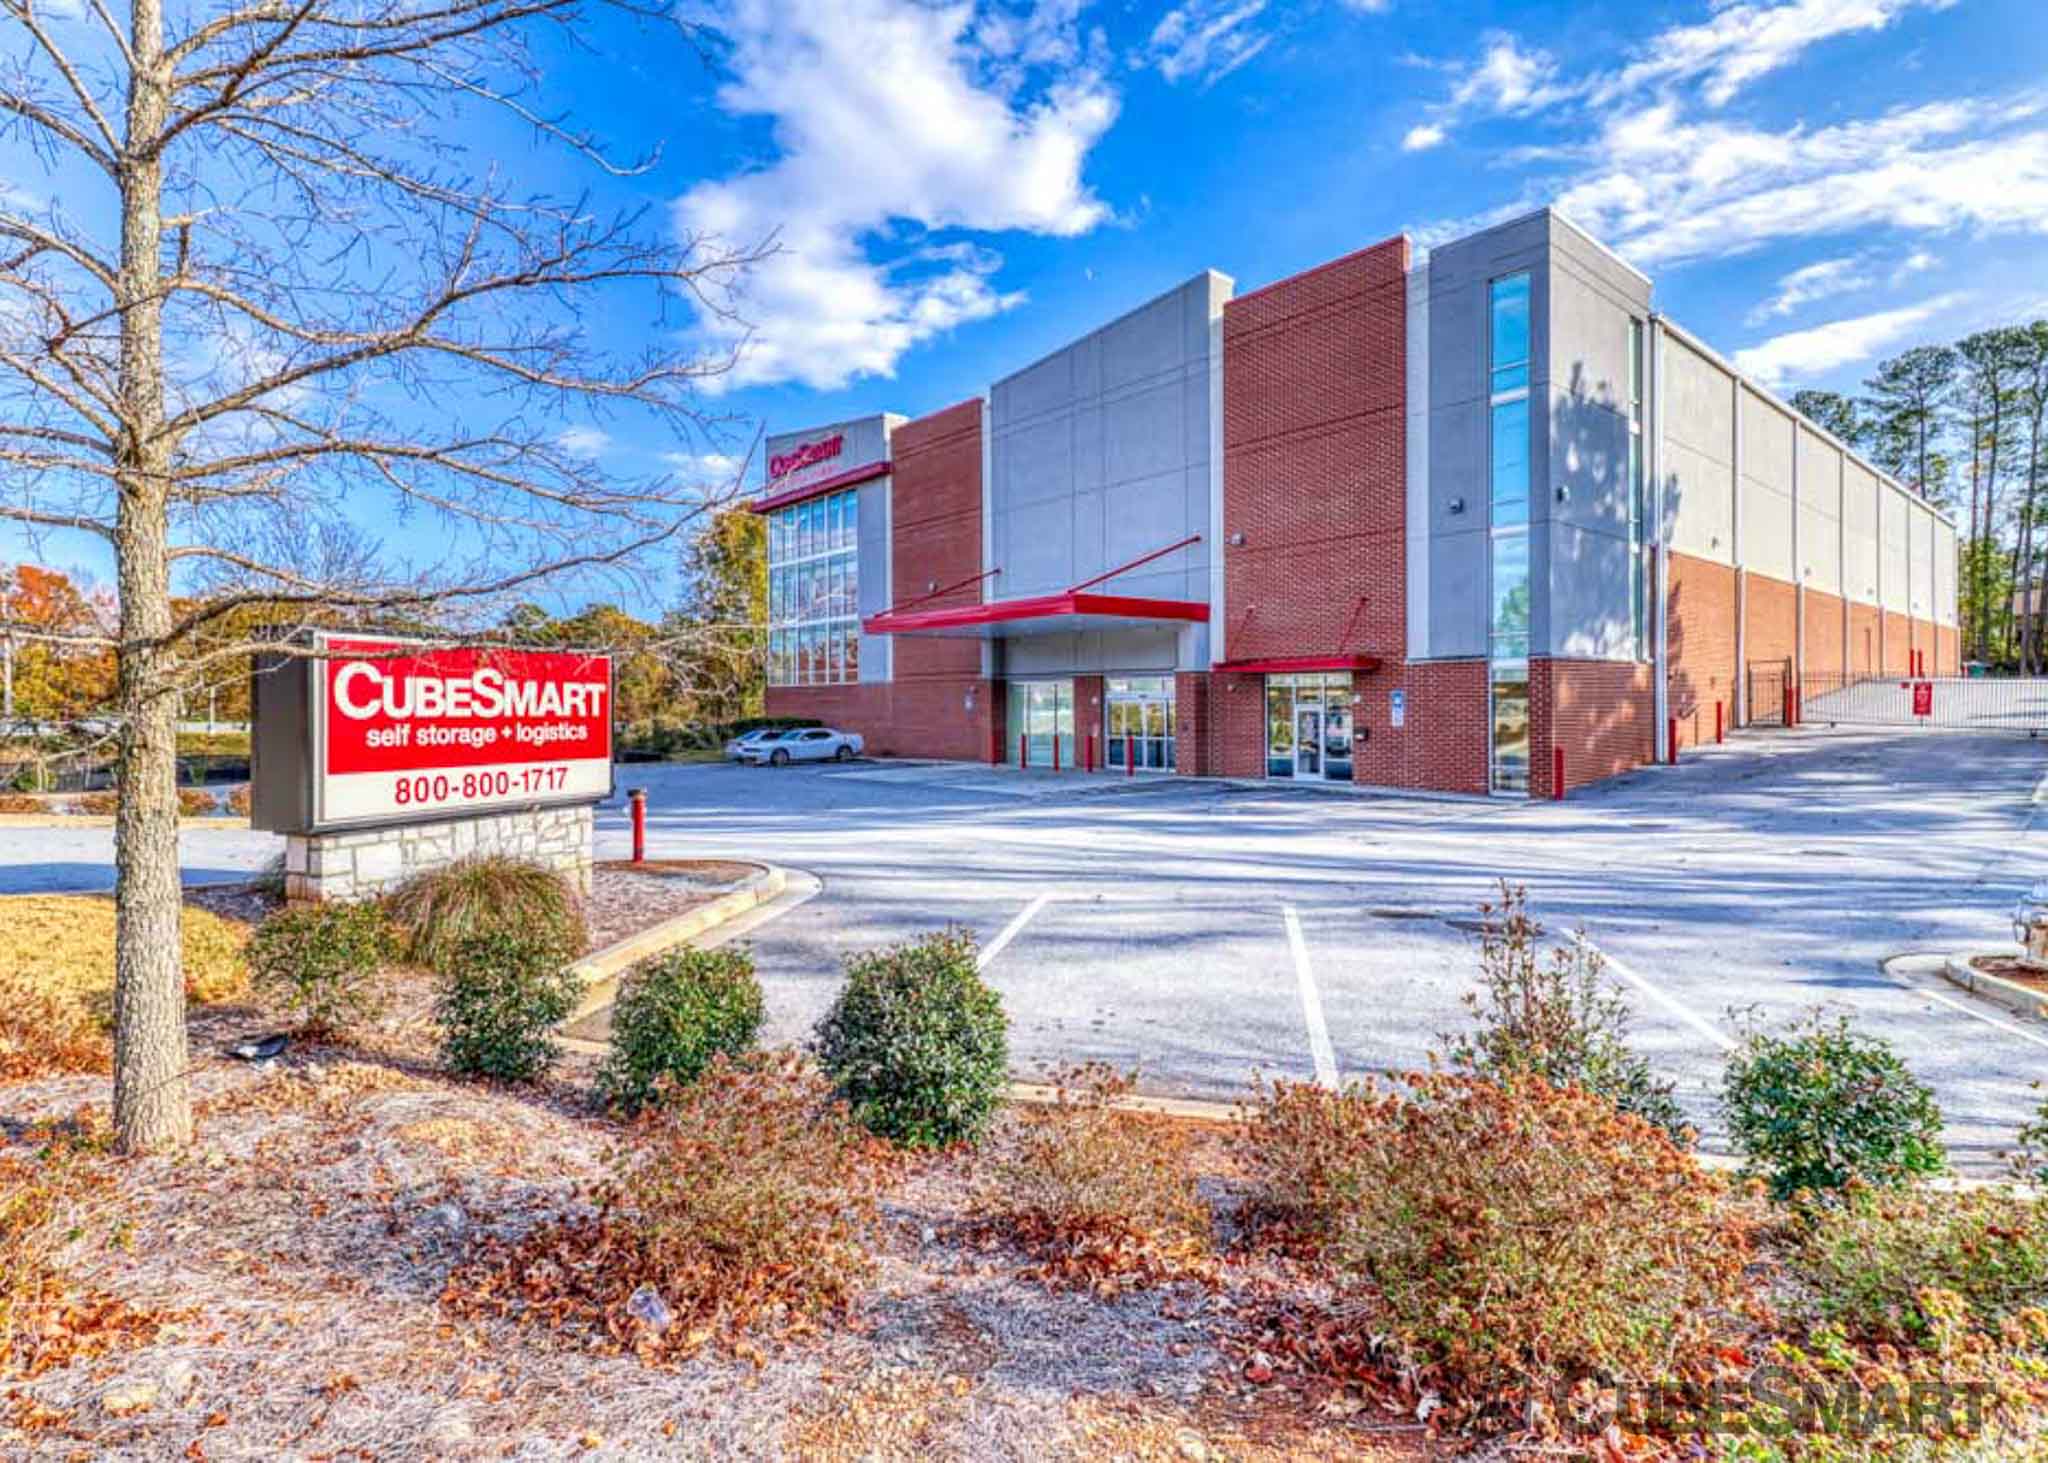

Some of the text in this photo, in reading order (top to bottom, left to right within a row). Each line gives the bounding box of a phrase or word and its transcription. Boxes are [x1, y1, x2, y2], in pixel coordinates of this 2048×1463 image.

[334, 662, 606, 718] CUBESMART
[366, 723, 411, 747] self
[416, 726, 496, 748] storage
[516, 723, 588, 744] logistics
[395, 767, 569, 804] 800-800-1717
